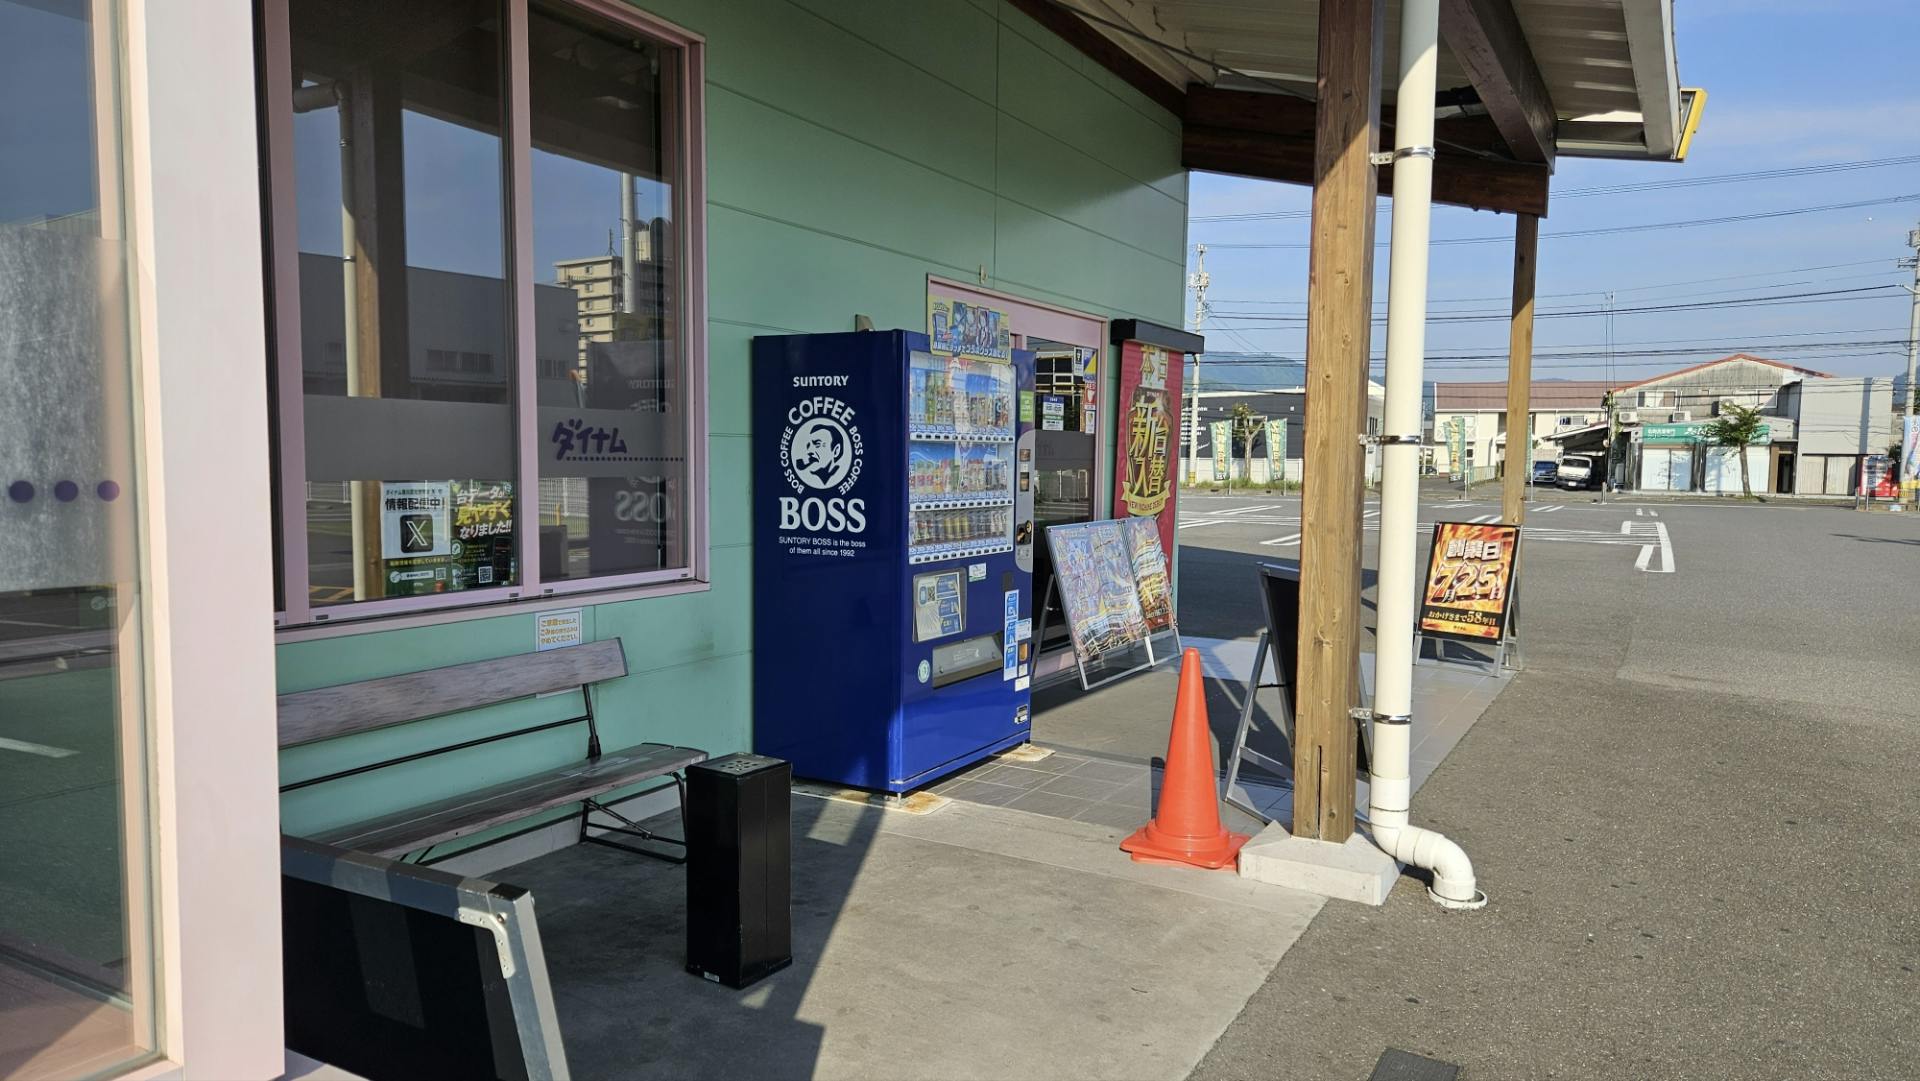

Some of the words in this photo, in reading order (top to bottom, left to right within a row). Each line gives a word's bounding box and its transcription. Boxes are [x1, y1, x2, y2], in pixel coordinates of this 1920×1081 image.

[793, 375, 849, 387] SUNTORY
[788, 396, 856, 426] COFFEE
[552, 418, 627, 461] ダイナム
[779, 425, 794, 467] COFFEE
[848, 426, 864, 456] BOSS
[783, 467, 805, 495] BOSS
[838, 460, 863, 496] COFFEE
[456, 500, 512, 525] 見やすく
[779, 496, 866, 533] BOSS
[778, 536, 811, 545] SUNTORY
[812, 537, 831, 546] BOSS
[839, 539, 849, 547] the
[851, 539, 866, 548] boss
[796, 547, 811, 555] them
[822, 548, 838, 556] since
[839, 549, 855, 557] 1992
[1447, 539, 1501, 561] 創業日
